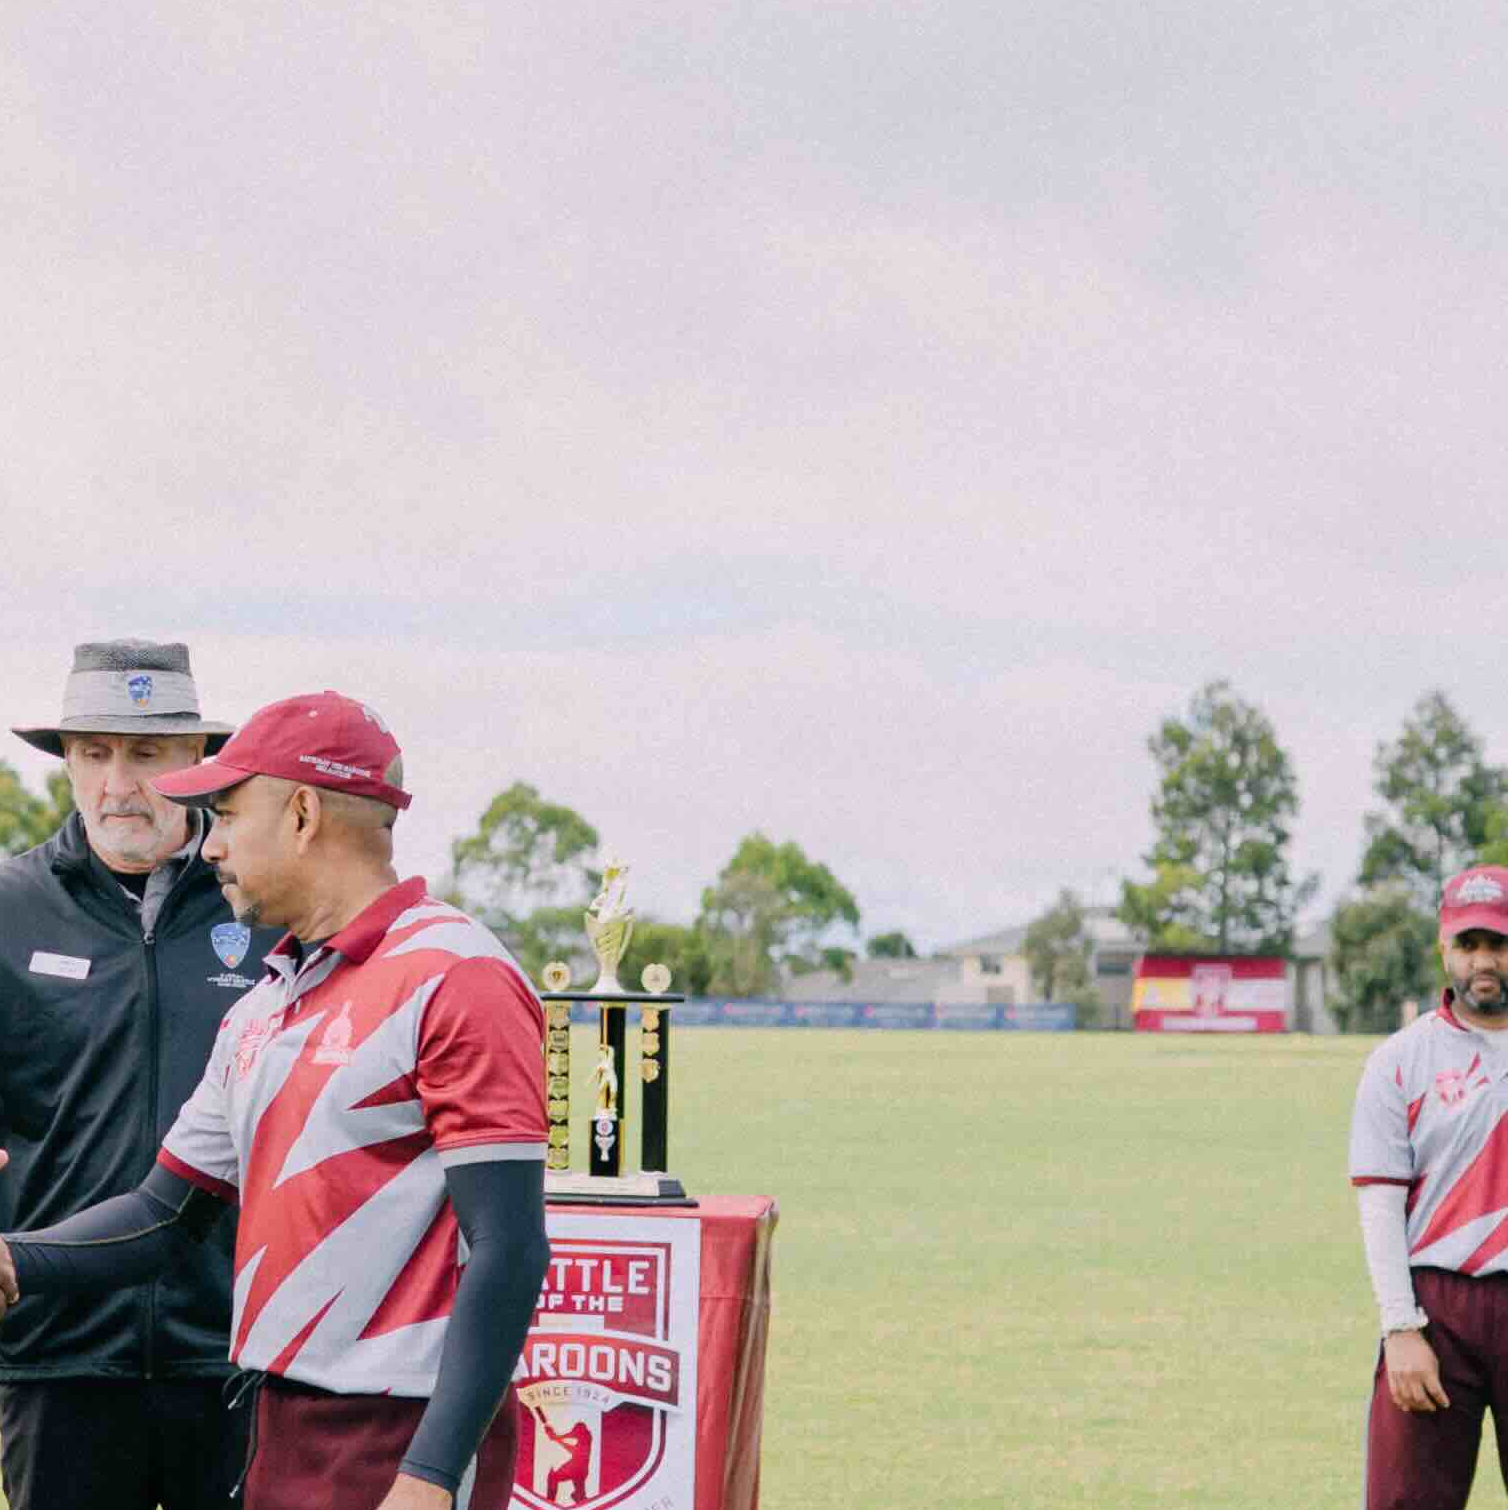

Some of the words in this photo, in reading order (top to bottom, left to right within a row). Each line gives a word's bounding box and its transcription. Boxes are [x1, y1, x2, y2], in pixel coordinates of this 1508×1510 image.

[542, 1258, 651, 1295] TTLE
[571, 1295, 624, 1312] THE
[524, 1386, 572, 1401] SINCE
